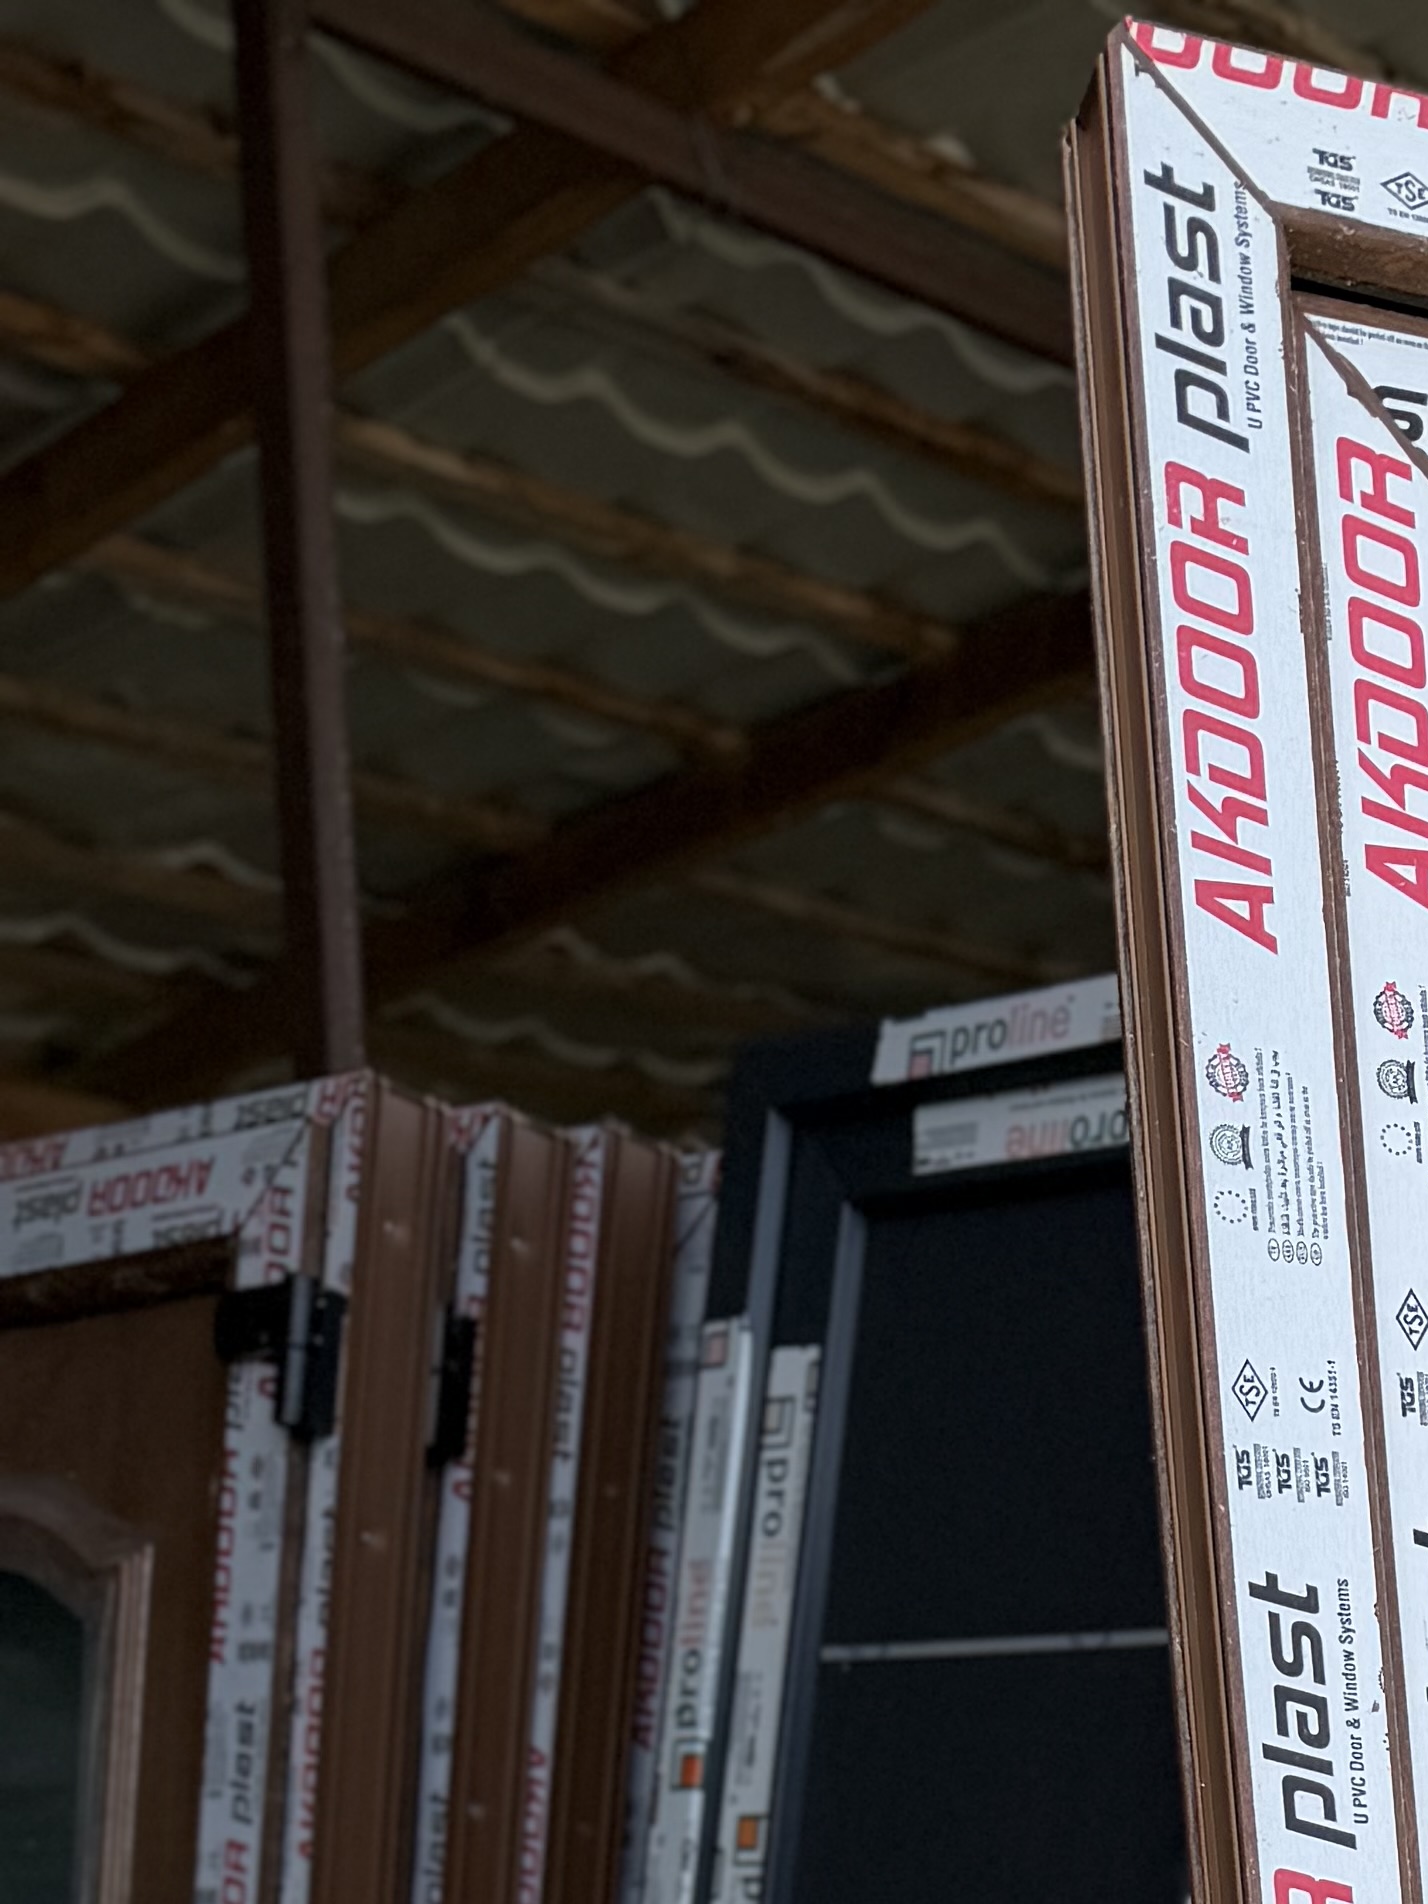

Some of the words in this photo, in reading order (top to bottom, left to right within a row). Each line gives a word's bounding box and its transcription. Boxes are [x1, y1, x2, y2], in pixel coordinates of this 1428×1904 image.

[1234, 178, 1252, 249] Systems
[1145, 161, 1250, 452] plast
[1236, 251, 1255, 315] Window
[1239, 322, 1256, 334] &
[1243, 337, 1260, 377] Door
[1244, 379, 1262, 414] PVC
[1246, 416, 1263, 430] U
[1163, 461, 1278, 954] AKDOOR
[950, 1003, 1071, 1066] proline
[1336, 1578, 1356, 1645] Systems
[1341, 1649, 1360, 1712] Window
[1249, 1572, 1356, 1849] plast
[1345, 1717, 1361, 1730] &
[1349, 1733, 1365, 1772] Door
[1350, 1776, 1368, 1809] PVC
[1353, 1812, 1369, 1825] U
